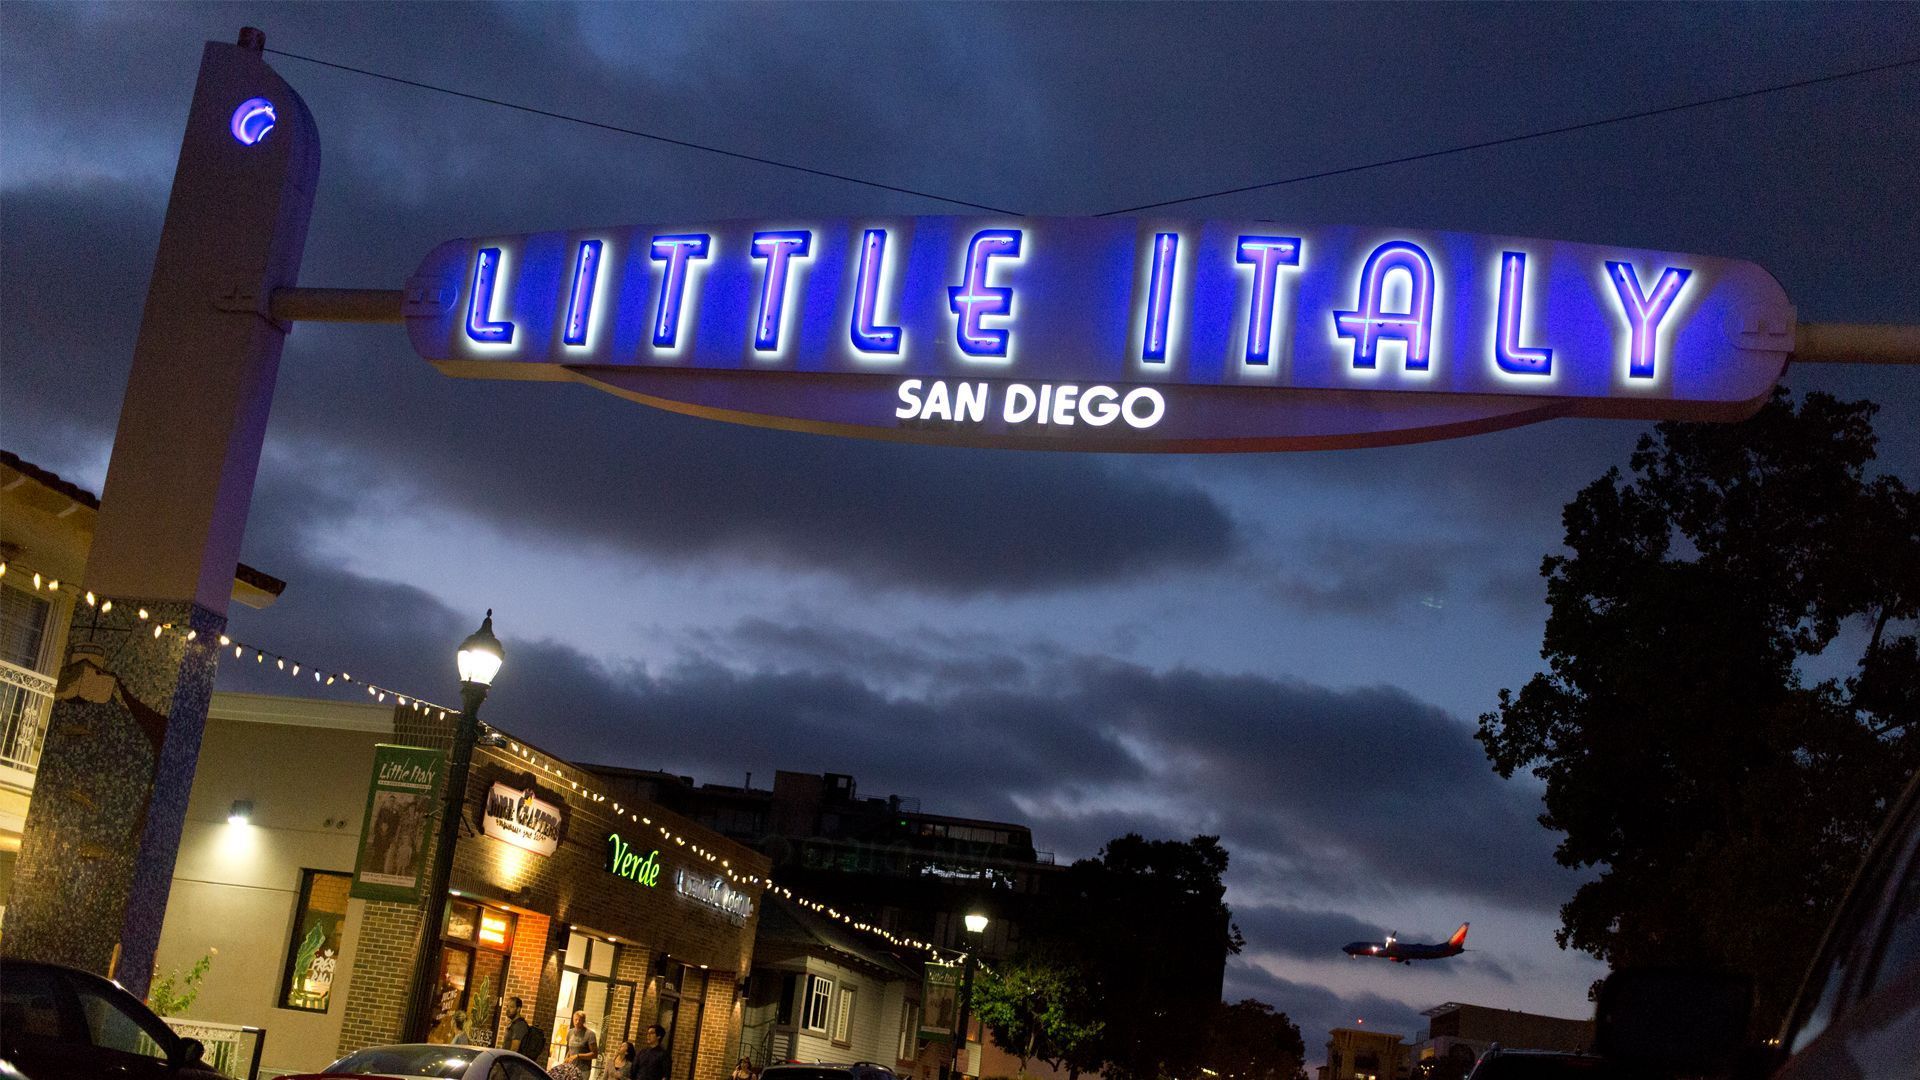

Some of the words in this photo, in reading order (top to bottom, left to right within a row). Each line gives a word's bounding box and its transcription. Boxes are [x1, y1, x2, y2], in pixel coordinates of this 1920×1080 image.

[464, 229, 1025, 359] LITTLE
[1141, 232, 1693, 381] ITALY
[895, 378, 989, 423] SAN
[1002, 383, 1166, 429] DIEGO
[379, 758, 410, 782] Little
[409, 758, 436, 786] Italy
[608, 833, 660, 888] Verde
